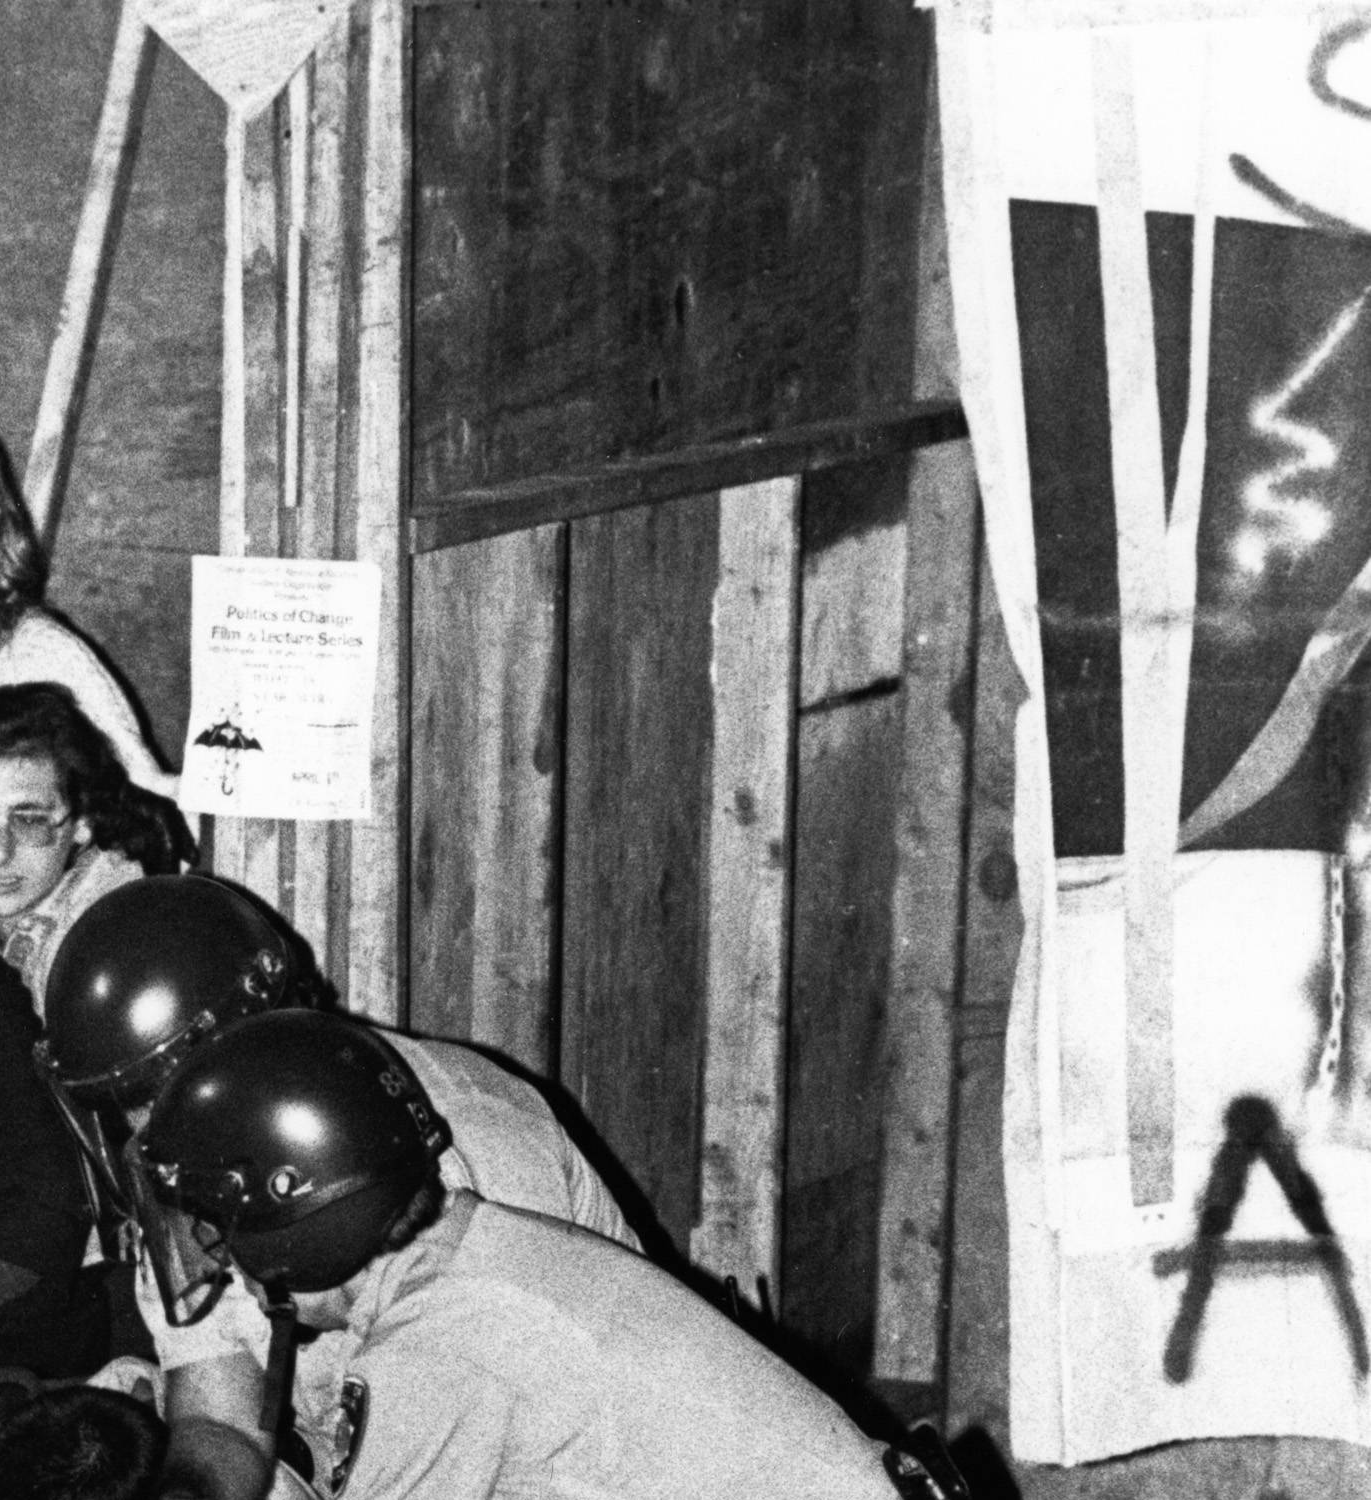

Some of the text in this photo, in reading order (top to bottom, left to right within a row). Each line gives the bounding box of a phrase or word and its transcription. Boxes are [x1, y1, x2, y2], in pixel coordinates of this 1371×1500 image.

[225, 604, 354, 628] Politics of Change
[211, 625, 242, 641] Film
[261, 628, 315, 646] Lecture
[317, 631, 364, 648] Series
[1151, 1092, 1370, 1395] A
